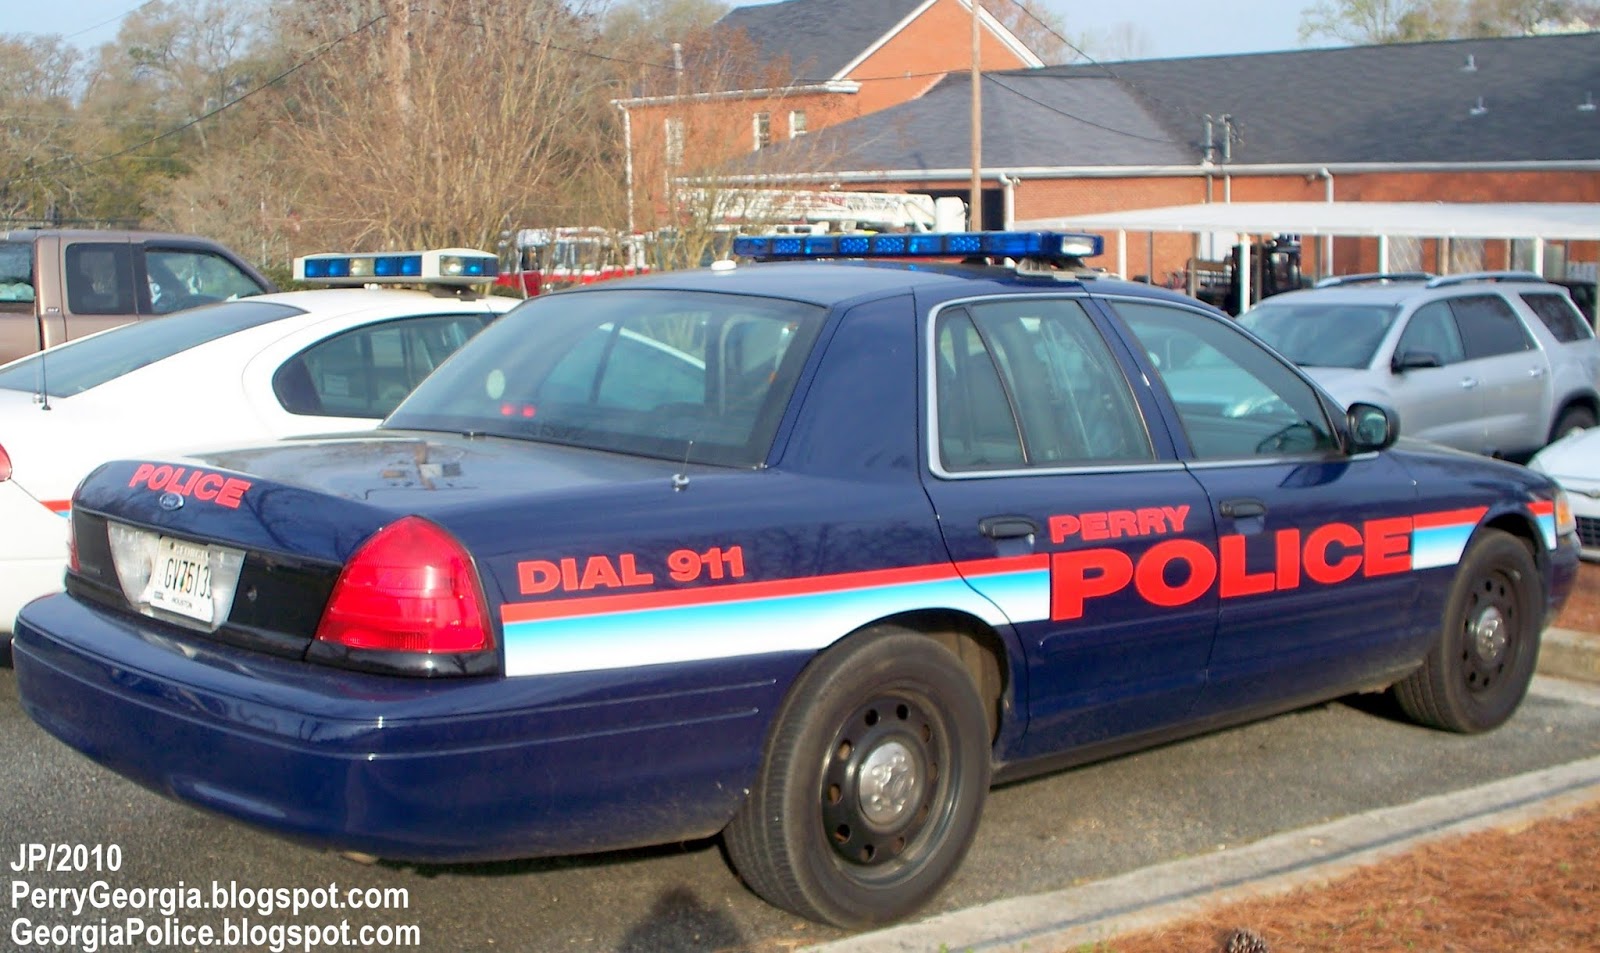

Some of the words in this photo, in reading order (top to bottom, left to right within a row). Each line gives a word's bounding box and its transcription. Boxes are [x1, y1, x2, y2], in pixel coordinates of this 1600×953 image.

[129, 463, 252, 509] POLICE
[1049, 505, 1190, 544] PERRY
[517, 554, 654, 595] DIAL
[667, 546, 745, 582] 911
[1051, 516, 1413, 621] POLICE
